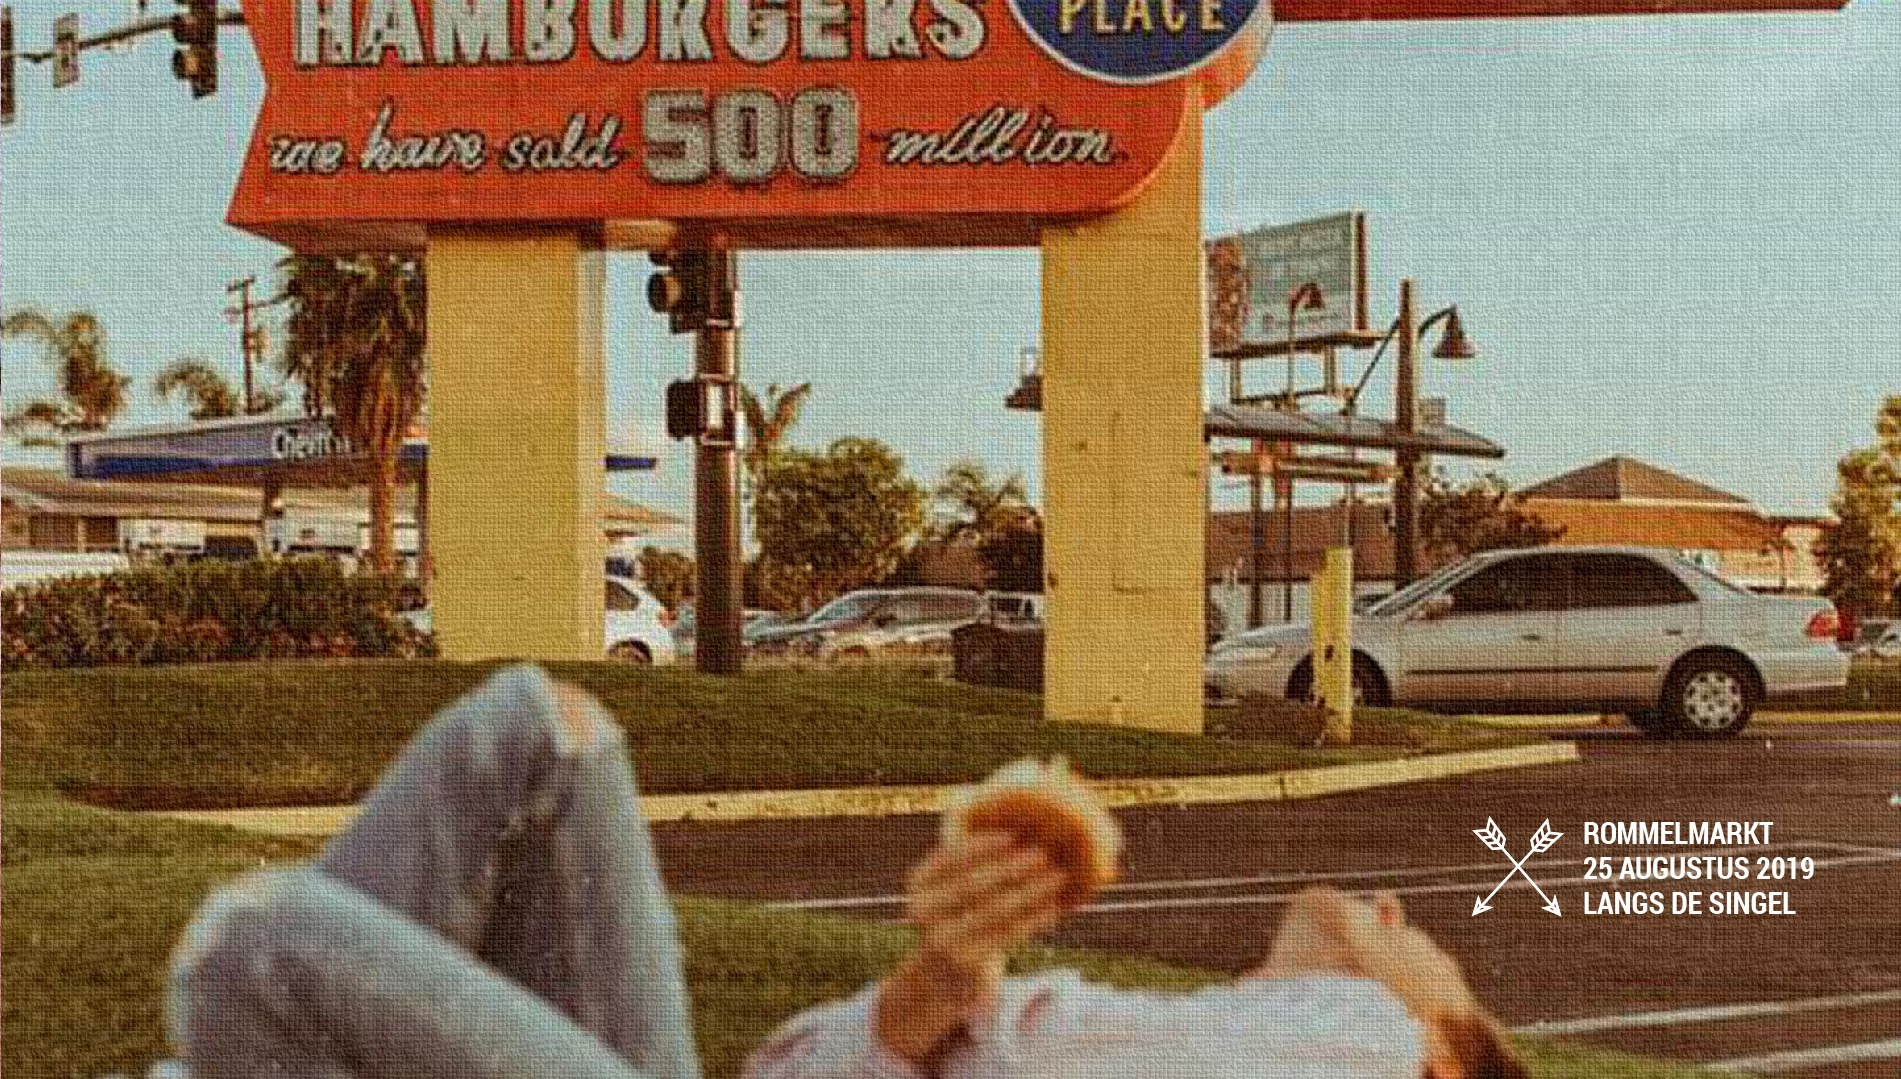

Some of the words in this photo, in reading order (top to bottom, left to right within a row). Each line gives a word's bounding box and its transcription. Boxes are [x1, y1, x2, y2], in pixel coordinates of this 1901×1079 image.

[295, 0, 986, 66] HAMBURGERS
[1059, 0, 1225, 33] PLACE
[270, 135, 344, 172] we
[361, 102, 486, 171] have
[504, 112, 622, 170] sold
[642, 87, 861, 184] 500
[884, 107, 1114, 166] million
